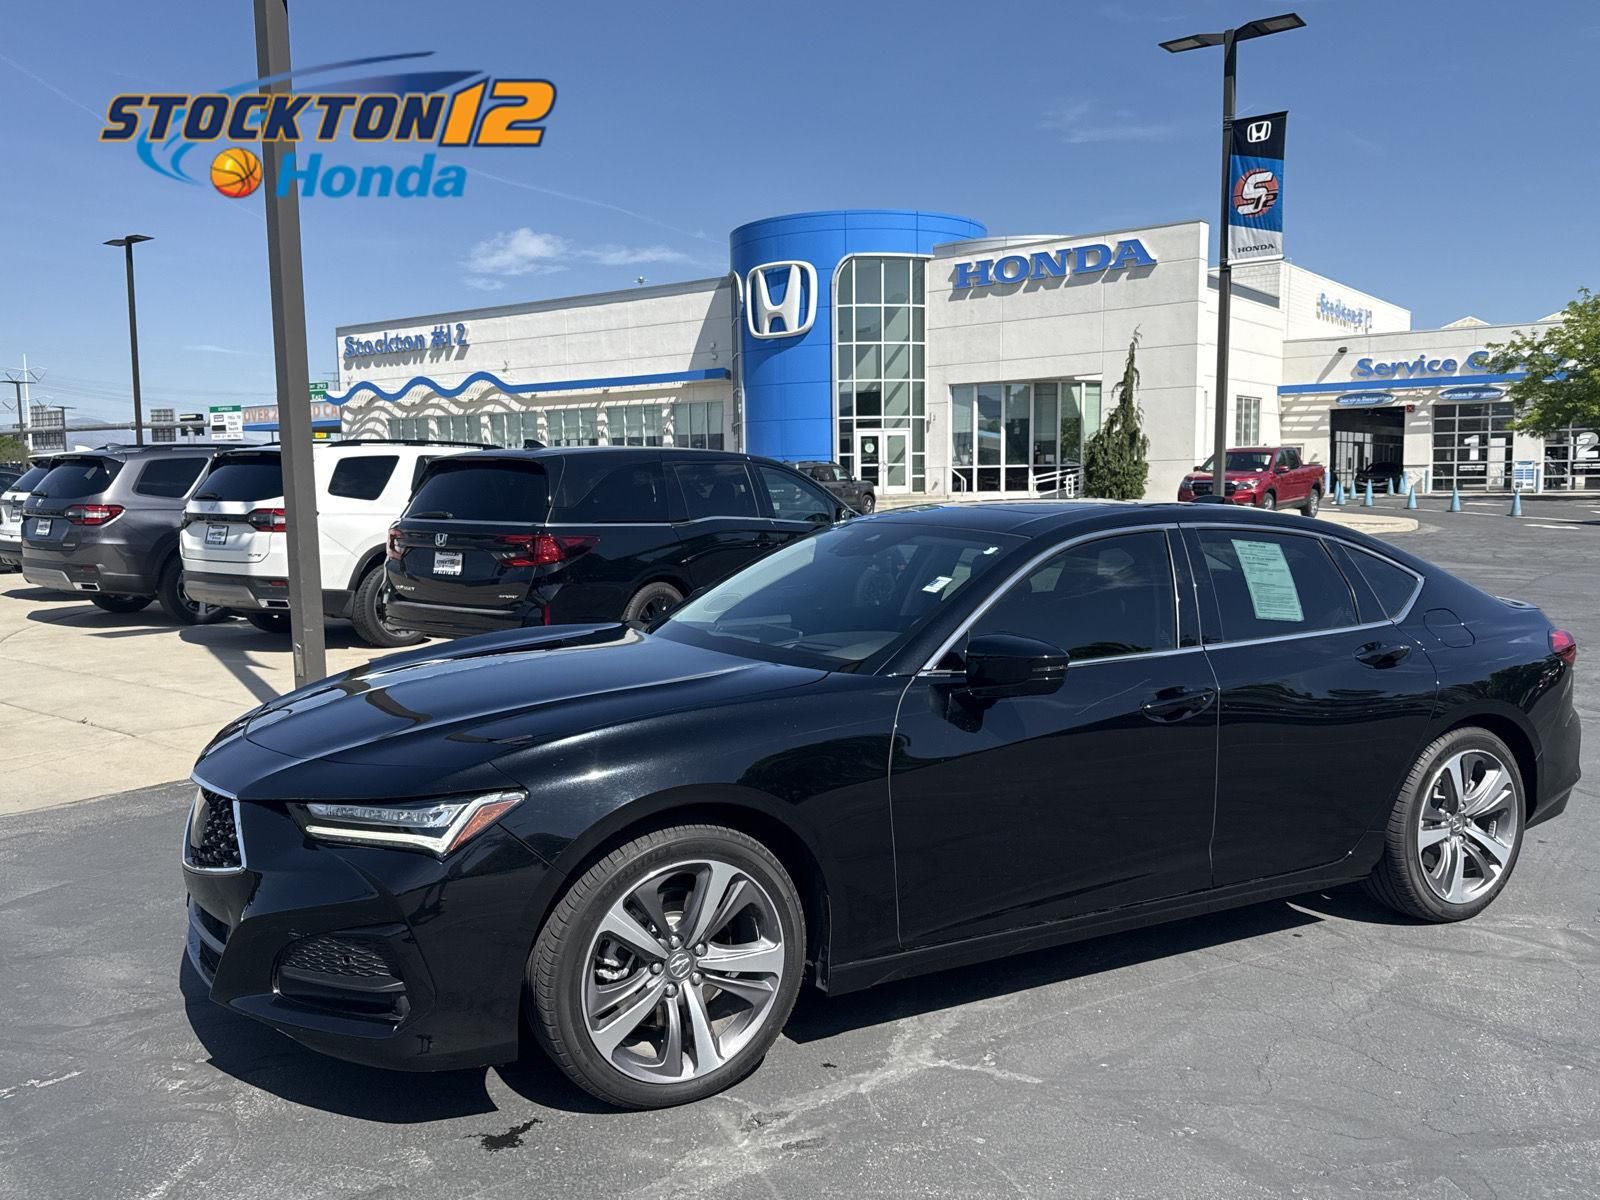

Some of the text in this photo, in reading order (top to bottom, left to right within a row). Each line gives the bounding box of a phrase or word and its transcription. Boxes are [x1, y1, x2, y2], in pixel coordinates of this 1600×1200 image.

[1238, 243, 1275, 253] HONDA
[953, 238, 1158, 290] HONDA
[344, 323, 467, 358] Stockton #12
[1357, 354, 1458, 378] Service
[244, 408, 270, 422] OVER
[1463, 434, 1480, 461] 1
[1576, 431, 1599, 459] 2
